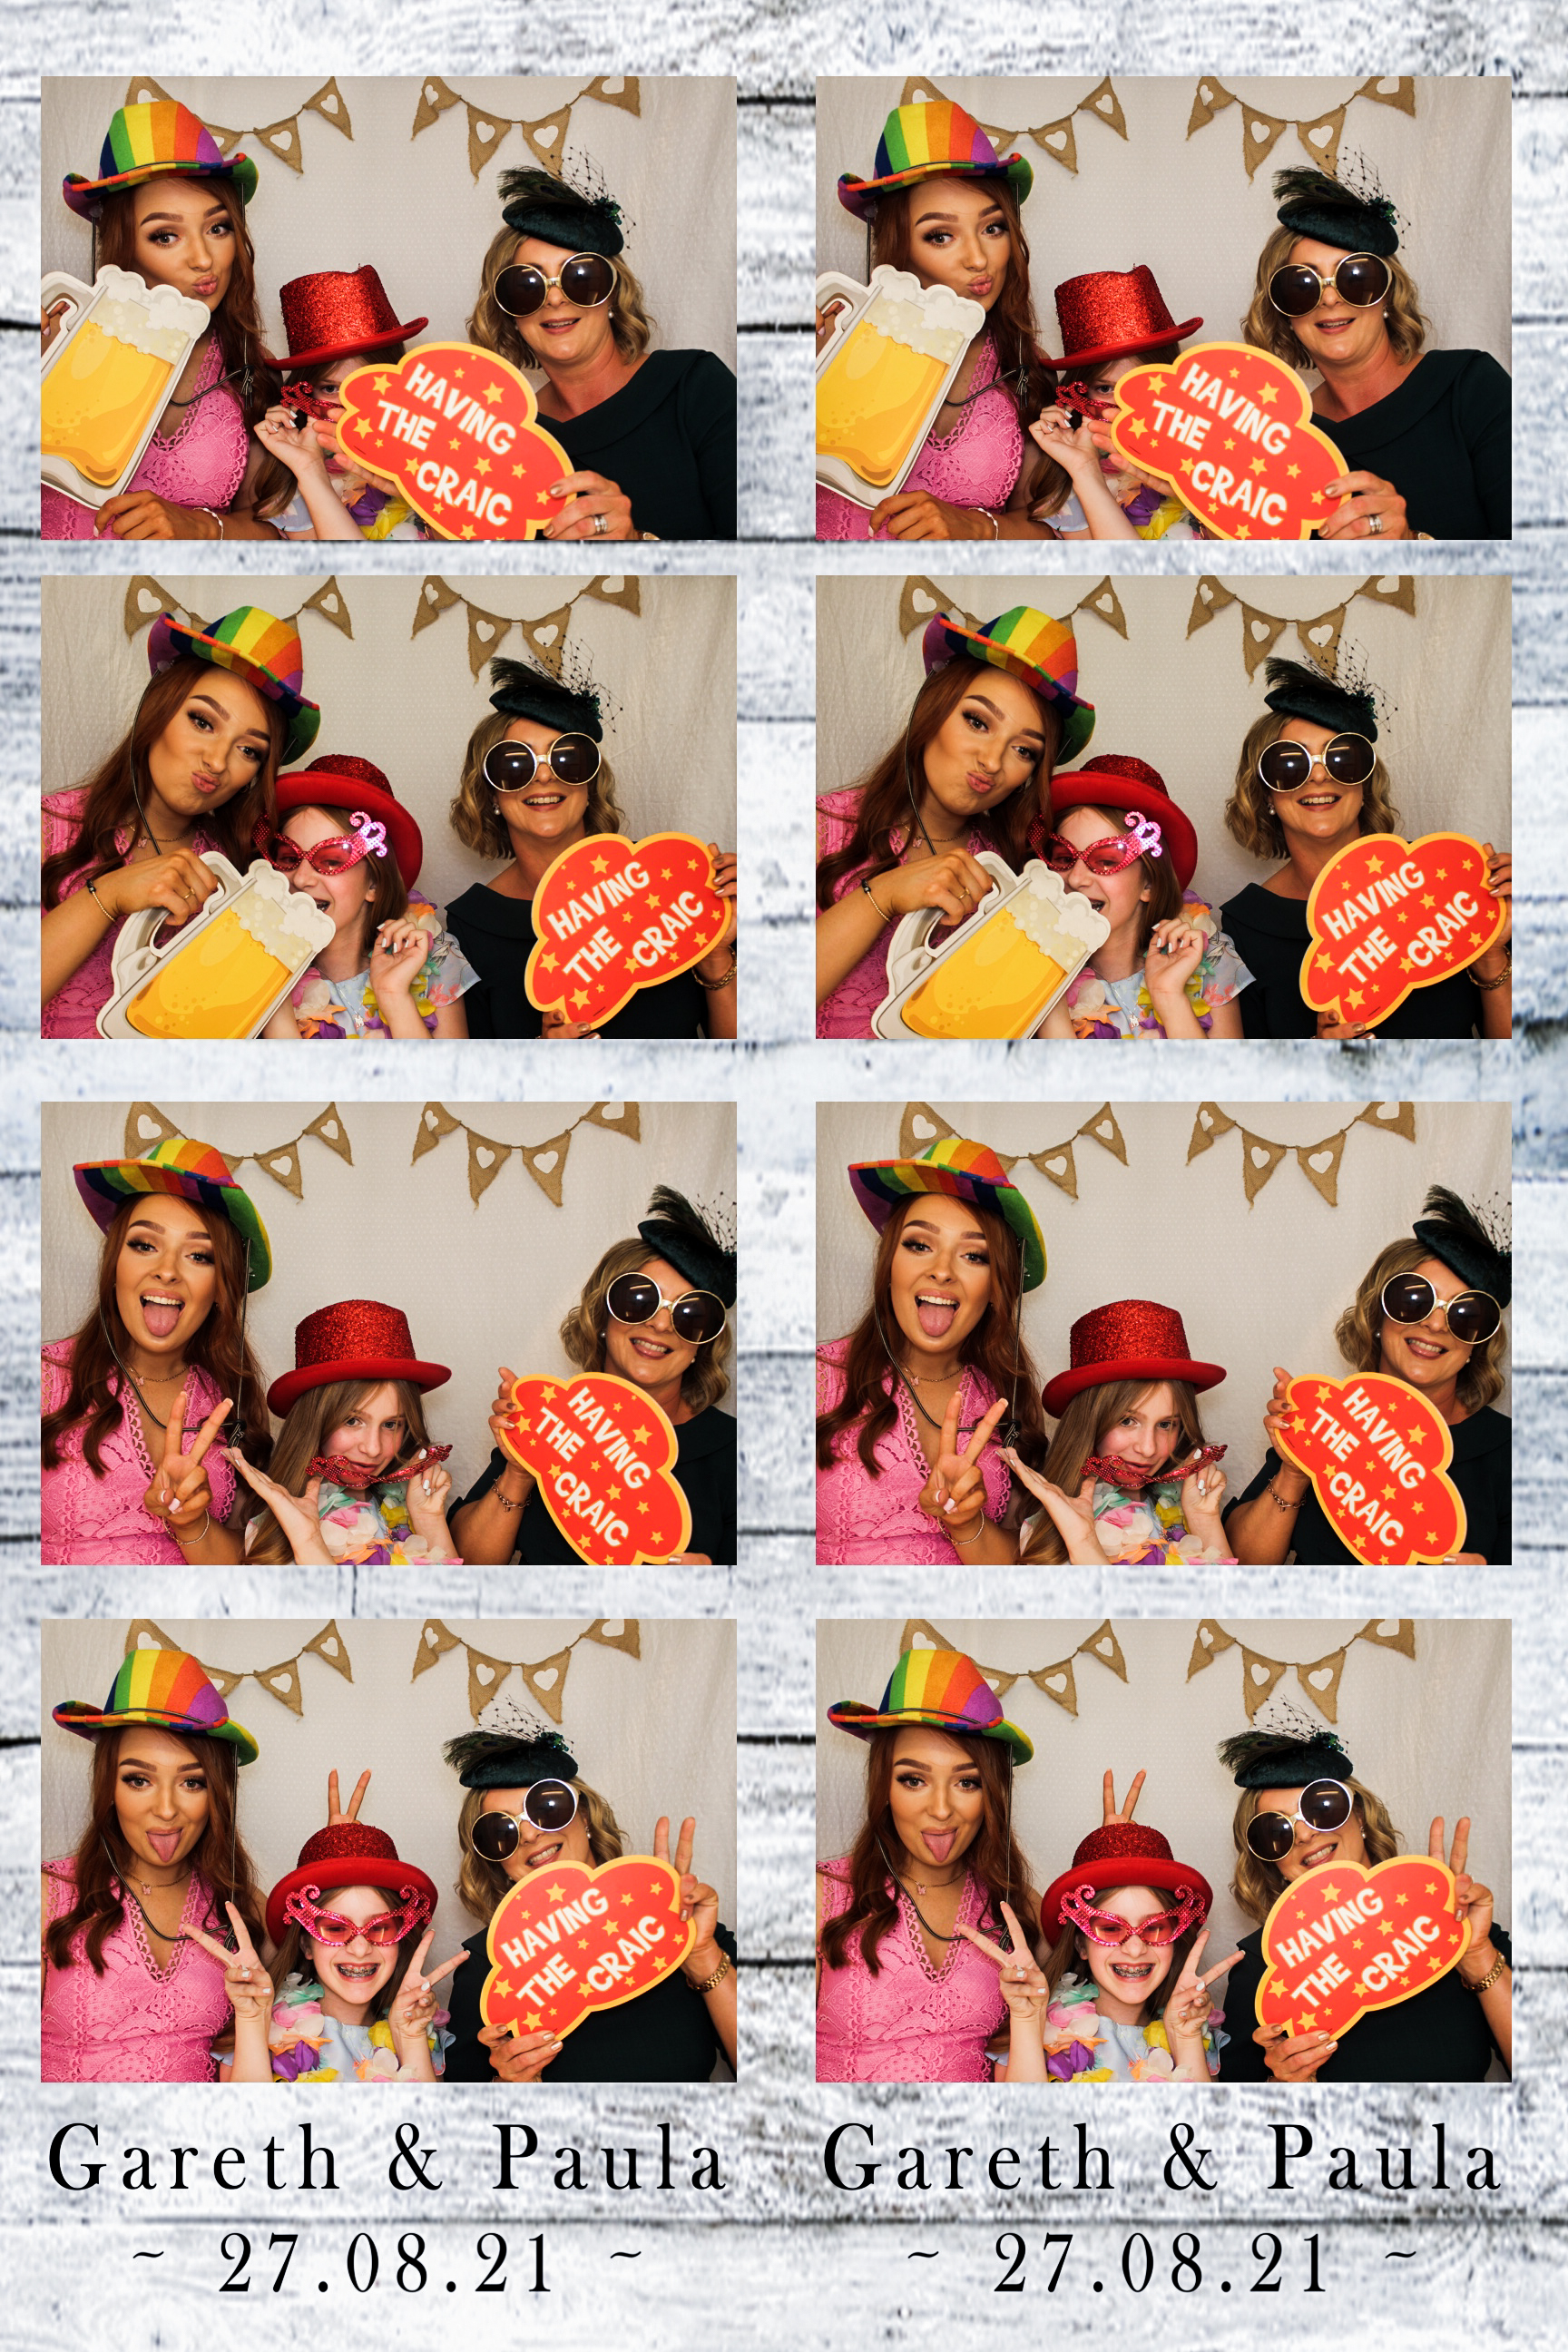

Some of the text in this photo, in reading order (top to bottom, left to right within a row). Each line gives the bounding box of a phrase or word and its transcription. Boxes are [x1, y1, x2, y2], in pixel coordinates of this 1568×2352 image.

[377, 399, 437, 451] THE
[408, 362, 516, 455] HAVING
[1152, 399, 1212, 451] THE
[1183, 362, 1291, 455] HAVING
[416, 460, 512, 525] CRAIC
[1191, 460, 1287, 525] CRAIC
[546, 861, 650, 941] HAVING
[563, 891, 703, 983] THE CRAIC
[1321, 861, 1425, 941] HAVING
[1338, 891, 1478, 983] THE CRAIC
[535, 1406, 585, 1462] THE
[567, 1387, 652, 1489] HAVING
[1310, 1406, 1360, 1462] THE
[1342, 1387, 1426, 1489] HAVING
[554, 1471, 629, 1547] CRAIC
[1329, 1471, 1404, 1547] CRAIC
[500, 1887, 609, 1968] HAVING
[515, 1916, 665, 2007] THE CRAIC
[1275, 1887, 1384, 1968] HAVING
[1290, 1916, 1440, 2007] THE CRAIC
